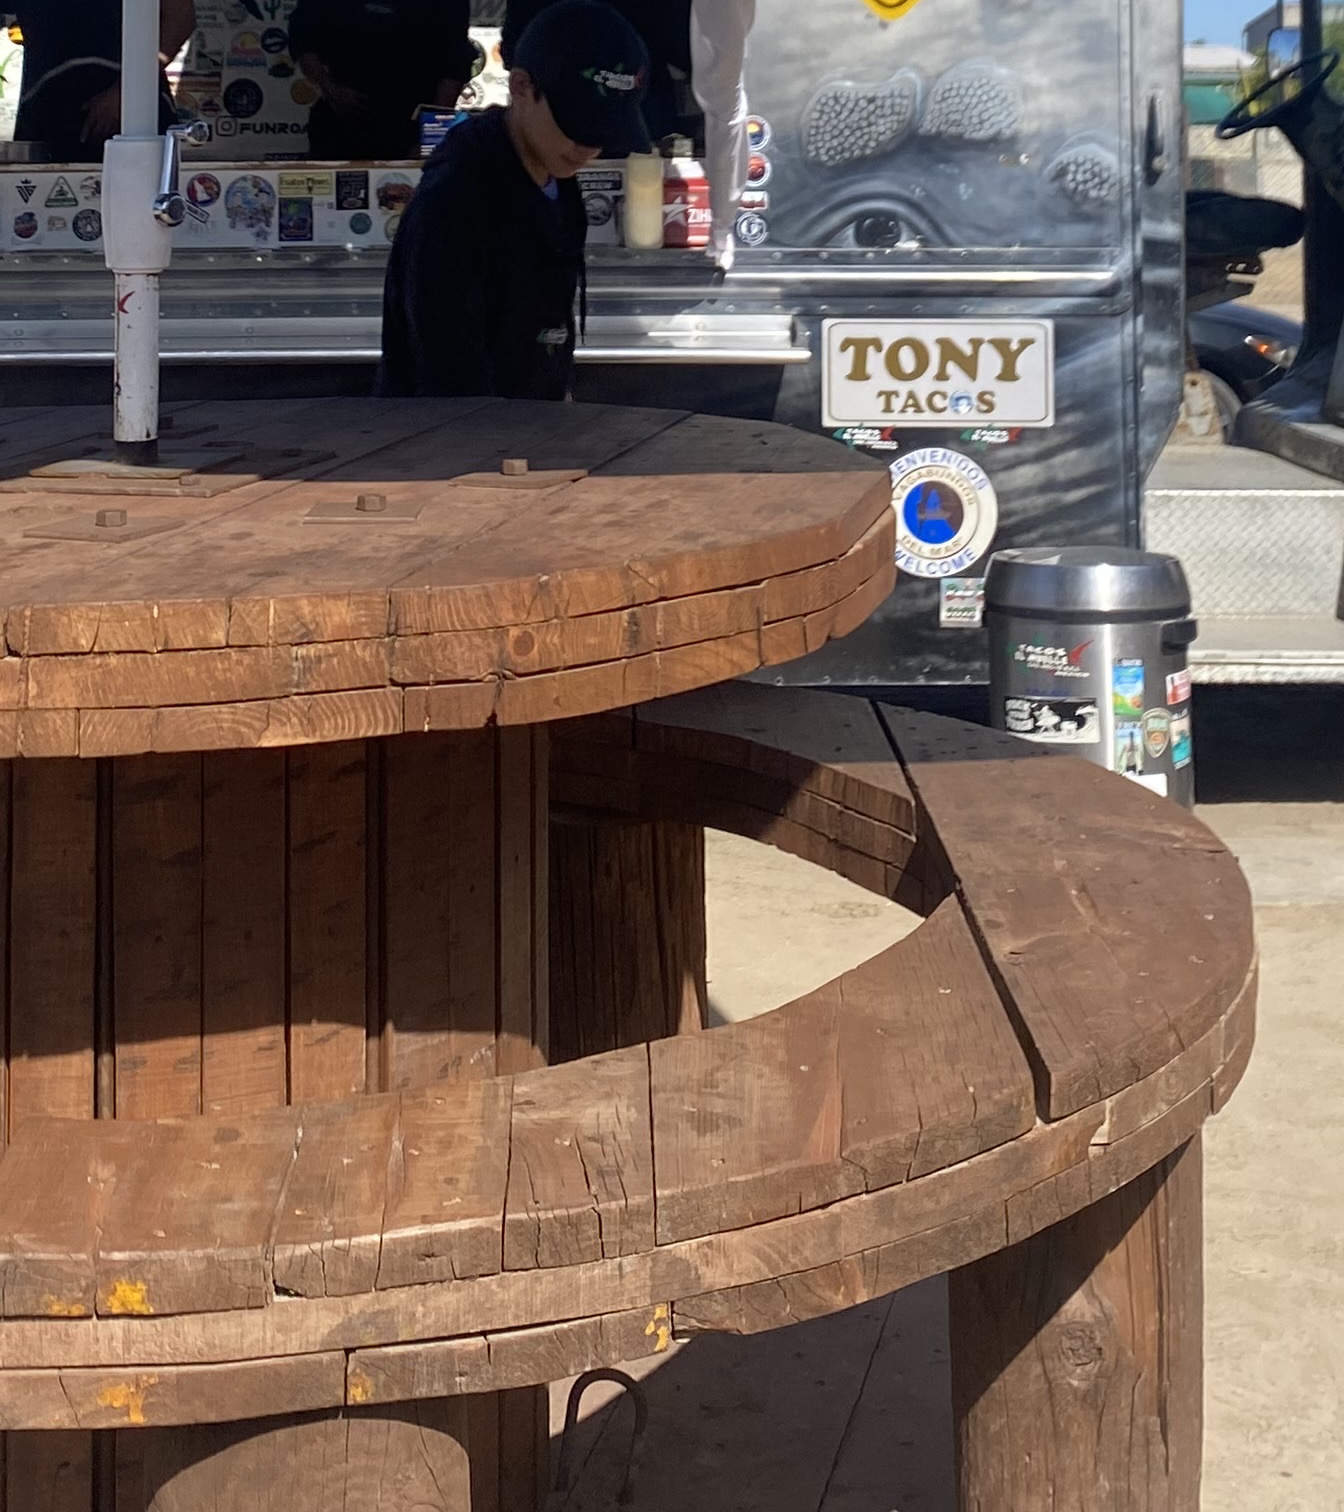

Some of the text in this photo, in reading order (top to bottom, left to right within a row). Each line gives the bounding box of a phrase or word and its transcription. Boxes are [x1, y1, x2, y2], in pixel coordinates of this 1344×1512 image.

[840, 337, 1036, 382] TONY
[876, 390, 996, 415] TACS
[901, 535, 964, 557] DEL MAR
[895, 547, 976, 575] WELCOME
